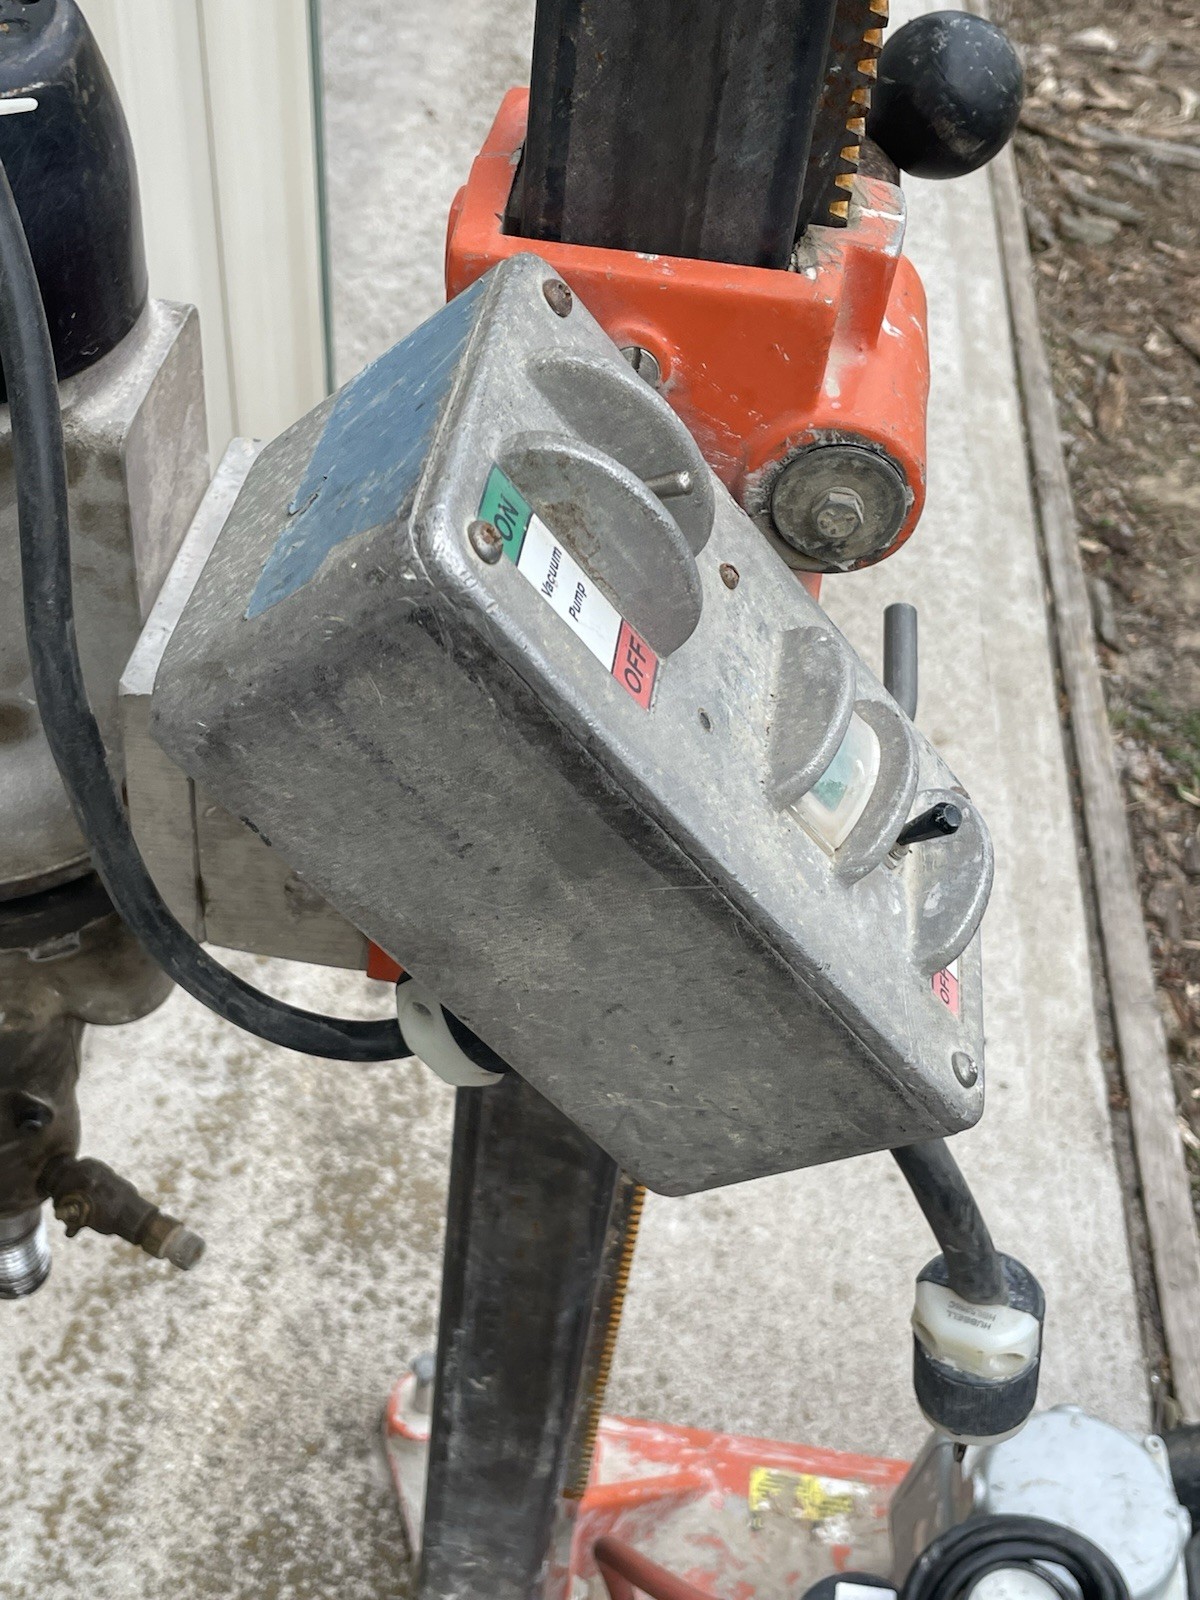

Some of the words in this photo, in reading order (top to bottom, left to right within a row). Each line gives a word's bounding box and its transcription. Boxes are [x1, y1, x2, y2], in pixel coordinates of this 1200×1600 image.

[493, 494, 519, 541] ON
[541, 546, 562, 598] Vacuum
[568, 582, 587, 622] Pump
[624, 634, 647, 694] OFF
